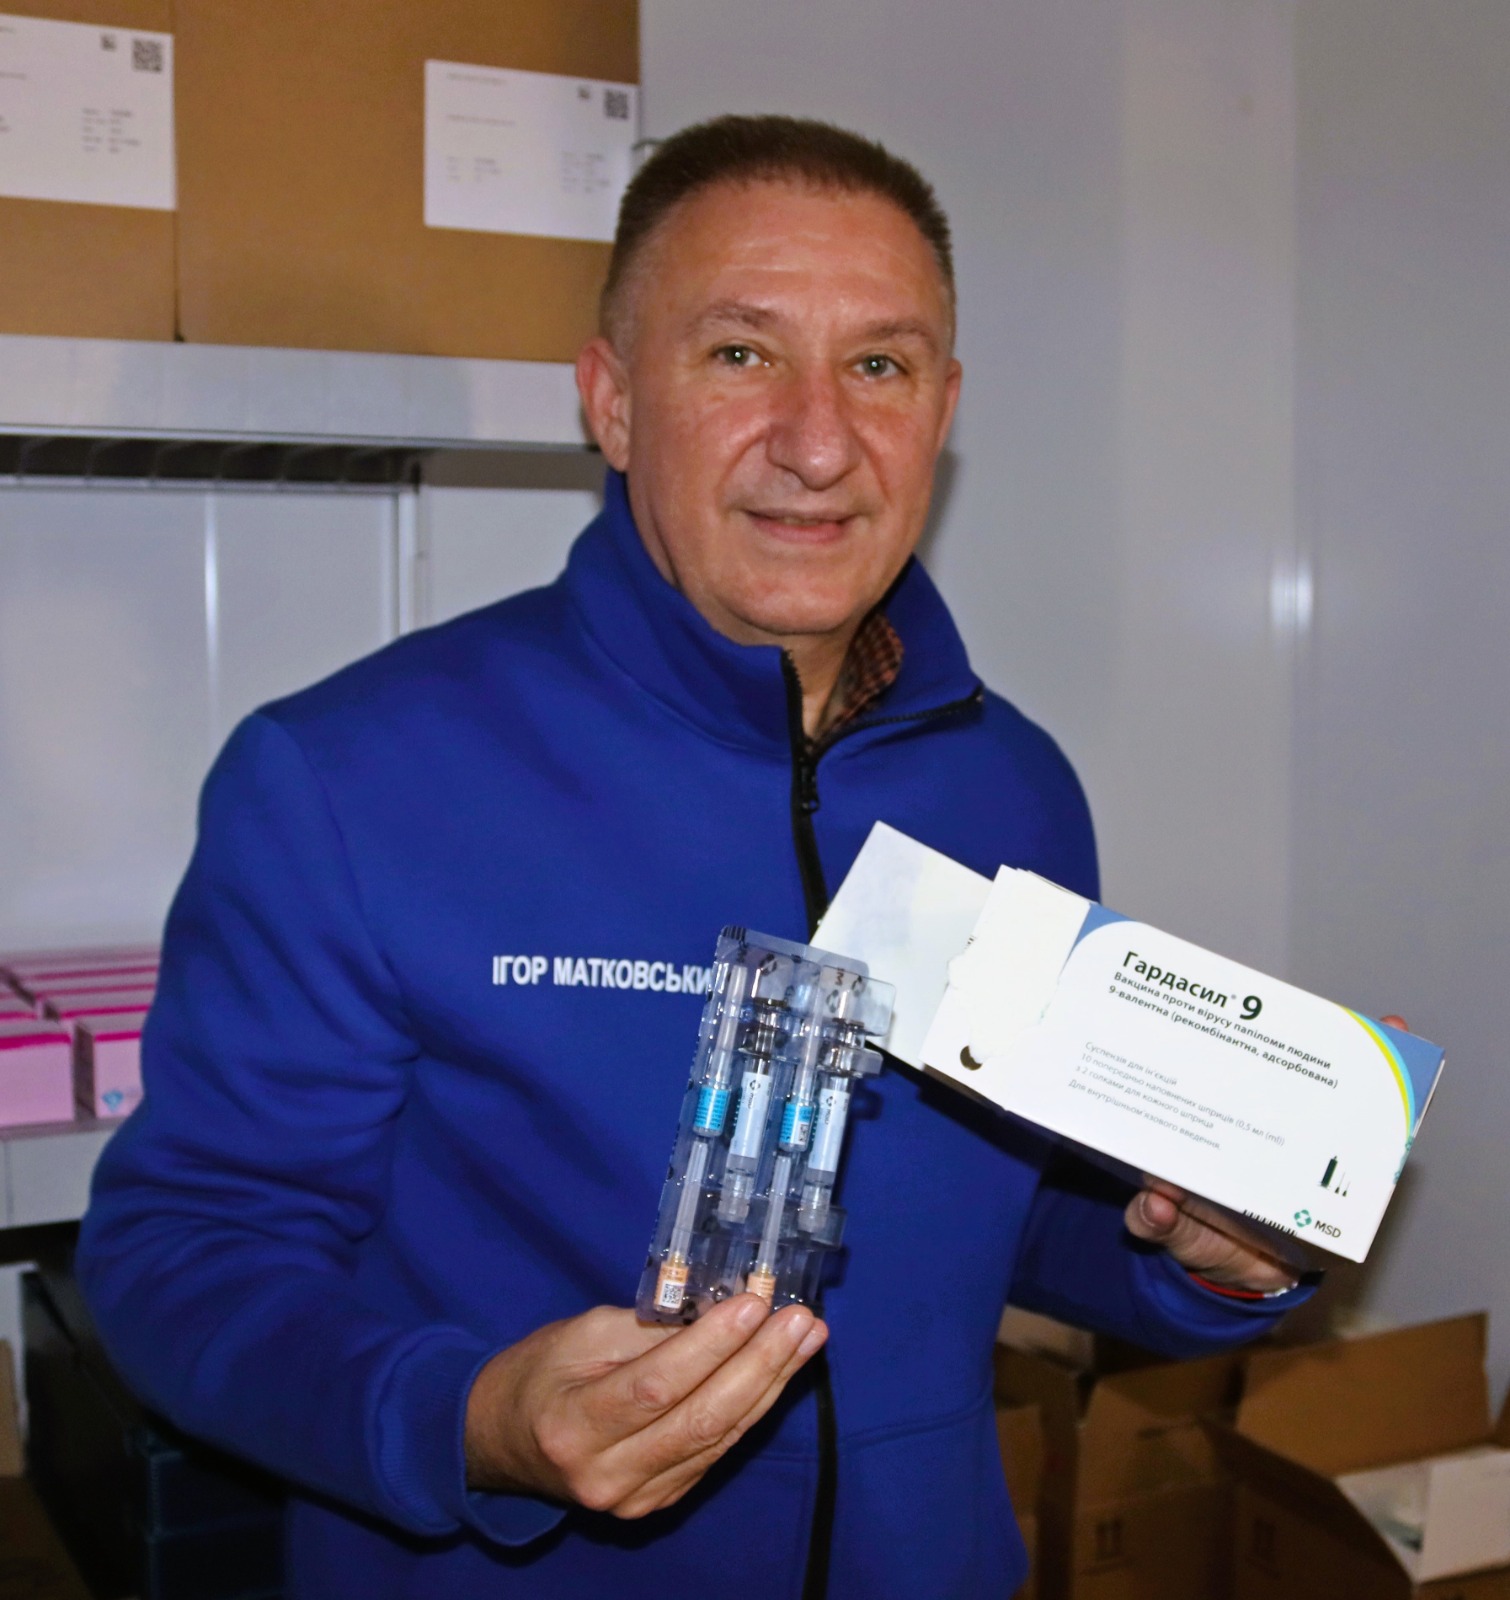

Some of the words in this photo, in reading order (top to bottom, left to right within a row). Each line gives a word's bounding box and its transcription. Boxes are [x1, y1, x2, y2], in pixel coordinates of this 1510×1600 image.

[492, 956, 548, 985] ІГОР
[553, 957, 712, 995] МАТКОВСЬКИ
[1113, 970, 1161, 998] Вакцина
[1161, 992, 1196, 1013] проти
[1196, 1007, 1233, 1030] вірусу
[1232, 1022, 1287, 1051] папіломи
[1286, 1045, 1332, 1071] людини
[1239, 995, 1263, 1021] 9
[1084, 1041, 1128, 1065] Суспензія
[1126, 1060, 1145, 1072] для
[1108, 984, 1170, 1017] 9-валентна
[1170, 1010, 1260, 1057] (рекомбінантна,
[1261, 1050, 1339, 1090] адсорбована)
[1067, 1078, 1087, 1092] Для
[1081, 1052, 1093, 1063] 10
[1092, 1059, 1145, 1086] попередньо
[1145, 1081, 1198, 1108] наповнених
[1197, 1104, 1235, 1125] шприців
[1251, 1127, 1265, 1137] мл
[1081, 1066, 1089, 1075] 2
[1088, 1071, 1125, 1091] голками
[1123, 1086, 1142, 1098] для
[1141, 1093, 1180, 1114] кожного
[1179, 1110, 1215, 1129] шприца
[1314, 1219, 1342, 1239] MSD
